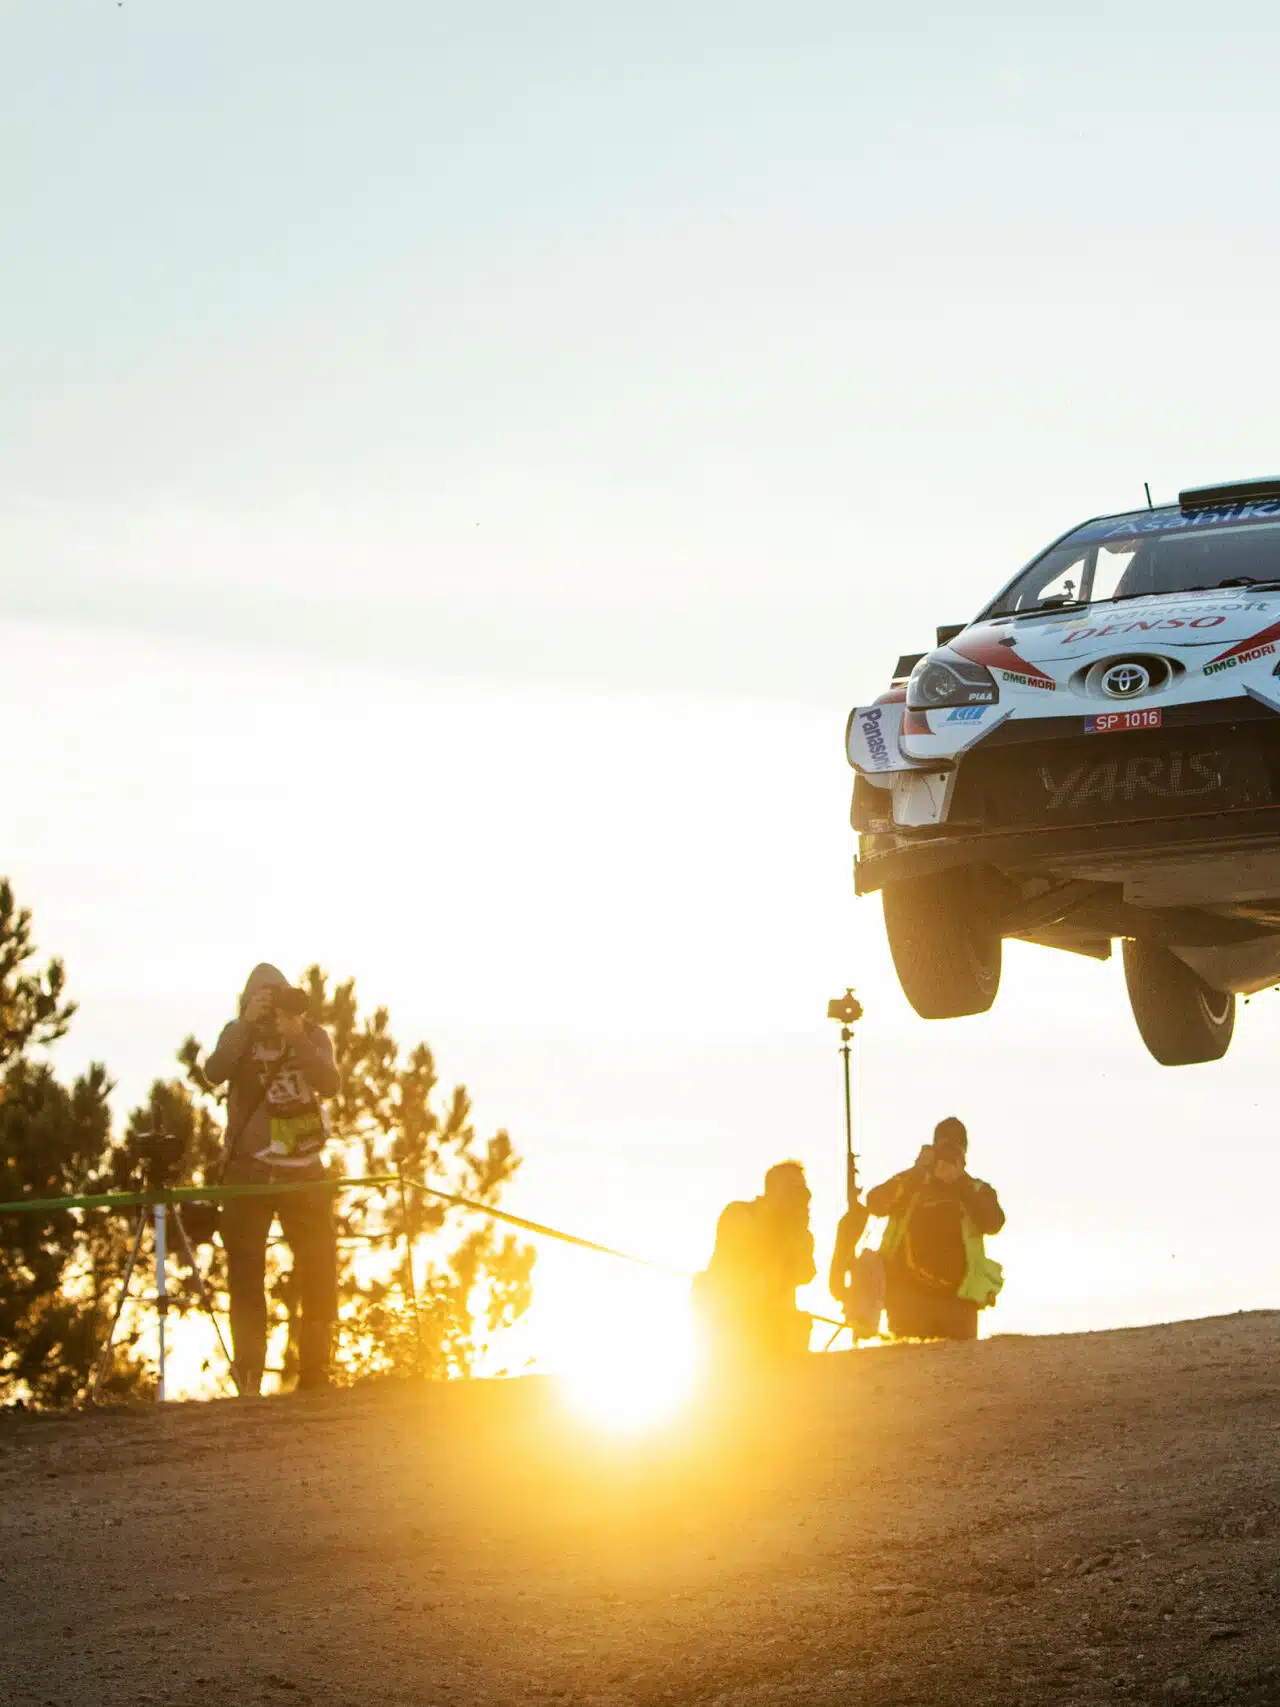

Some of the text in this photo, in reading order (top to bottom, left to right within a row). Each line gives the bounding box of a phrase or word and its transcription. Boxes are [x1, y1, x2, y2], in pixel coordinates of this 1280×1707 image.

[1061, 616, 1227, 644] DENSO
[1202, 644, 1277, 676] DMG MORI
[1002, 671, 1056, 692] DMG MORI
[967, 691, 993, 701] PIAA
[1096, 714, 1119, 730] SP
[1124, 711, 1158, 728] 1016
[1037, 751, 1222, 809] YARIS
